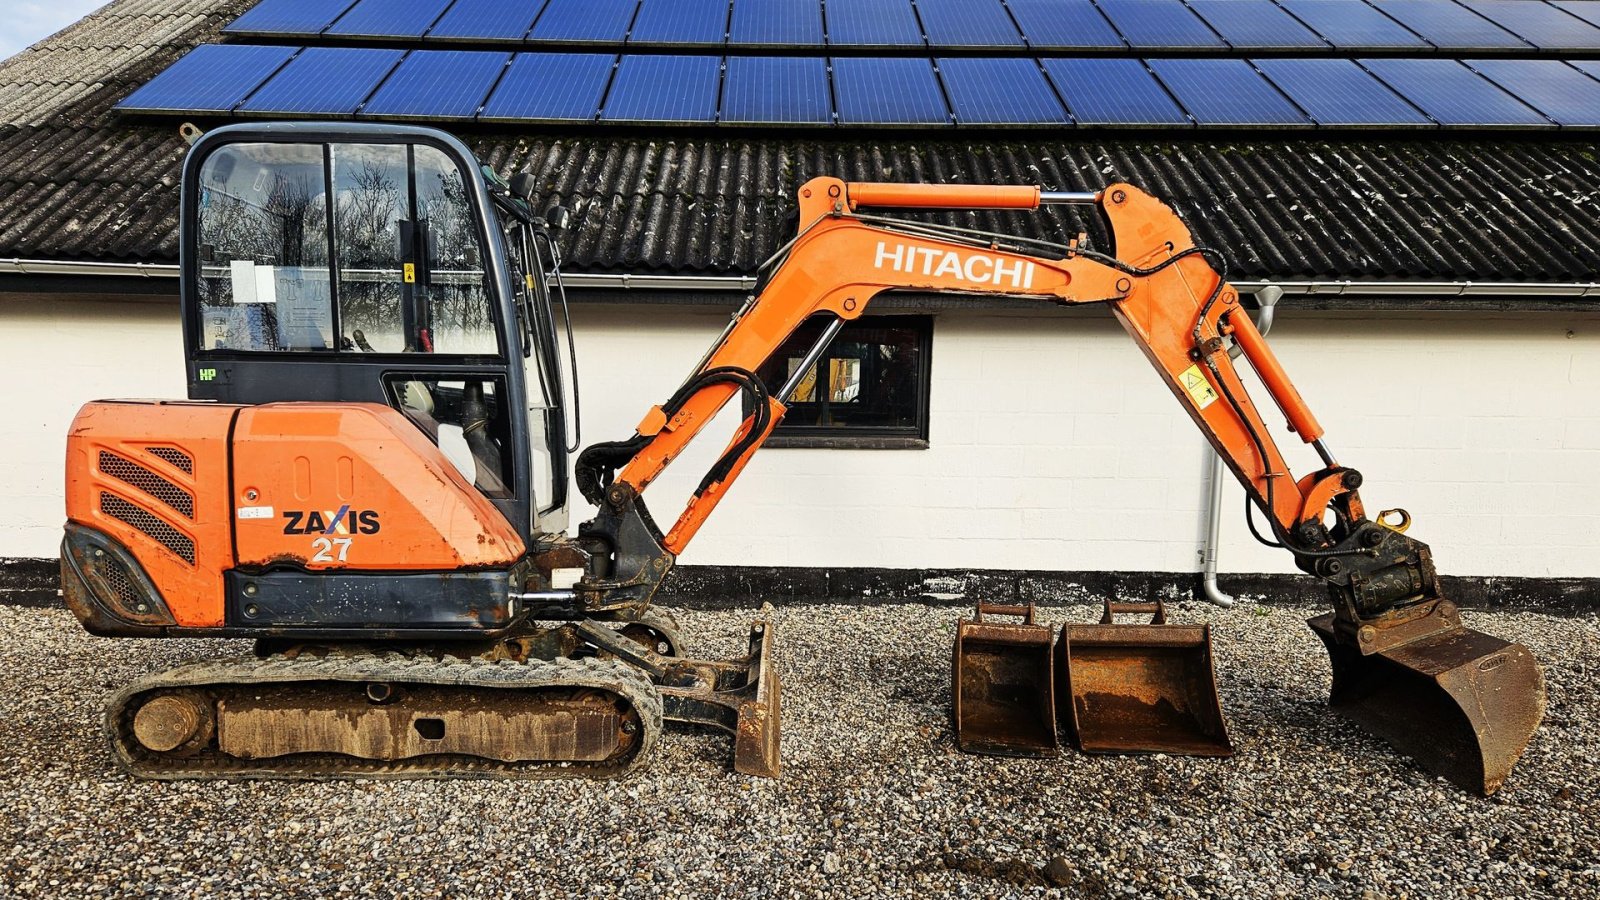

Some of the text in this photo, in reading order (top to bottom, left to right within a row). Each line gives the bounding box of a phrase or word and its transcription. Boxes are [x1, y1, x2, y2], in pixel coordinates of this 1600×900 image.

[874, 241, 1035, 289] HITACHI
[199, 368, 216, 381] HP
[283, 505, 380, 535] ZAXIS
[311, 537, 352, 562] 27
